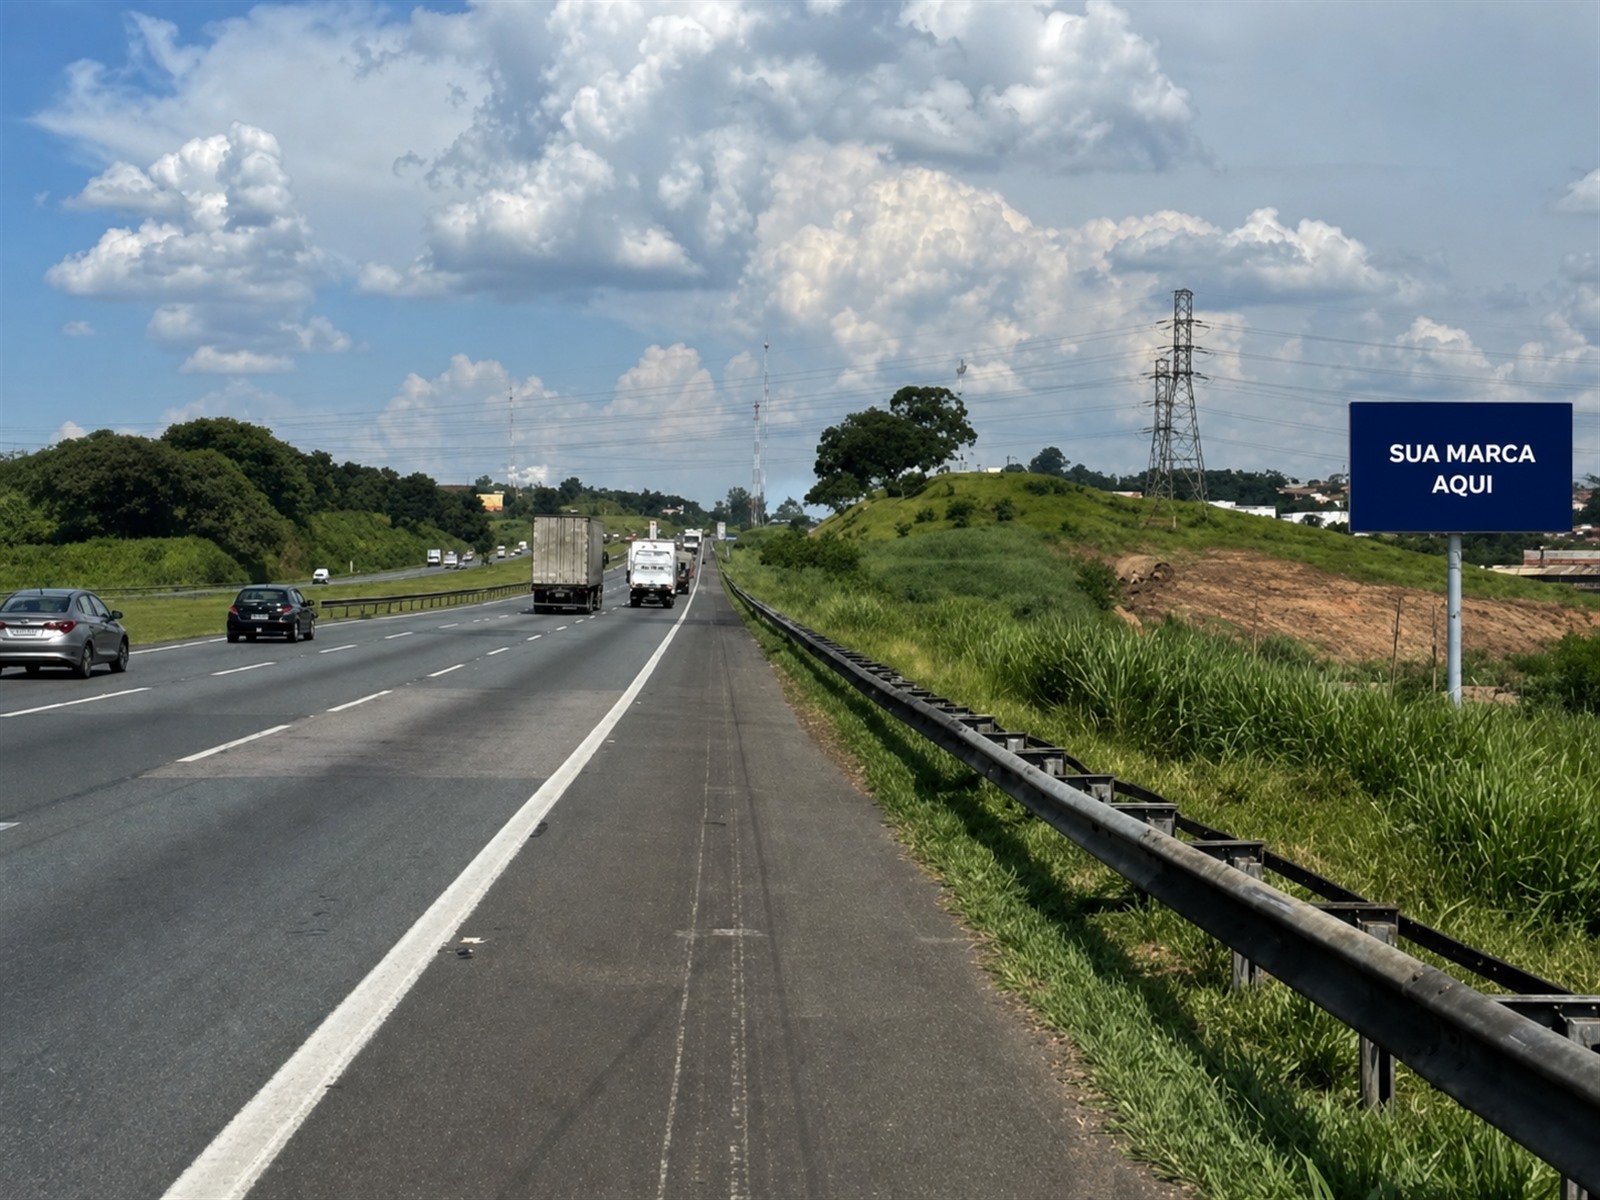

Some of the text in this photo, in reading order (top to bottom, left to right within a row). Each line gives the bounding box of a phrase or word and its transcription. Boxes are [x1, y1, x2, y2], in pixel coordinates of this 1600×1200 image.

[1389, 443, 1536, 463] SUA MARCA
[1432, 475, 1493, 497] AQUI
